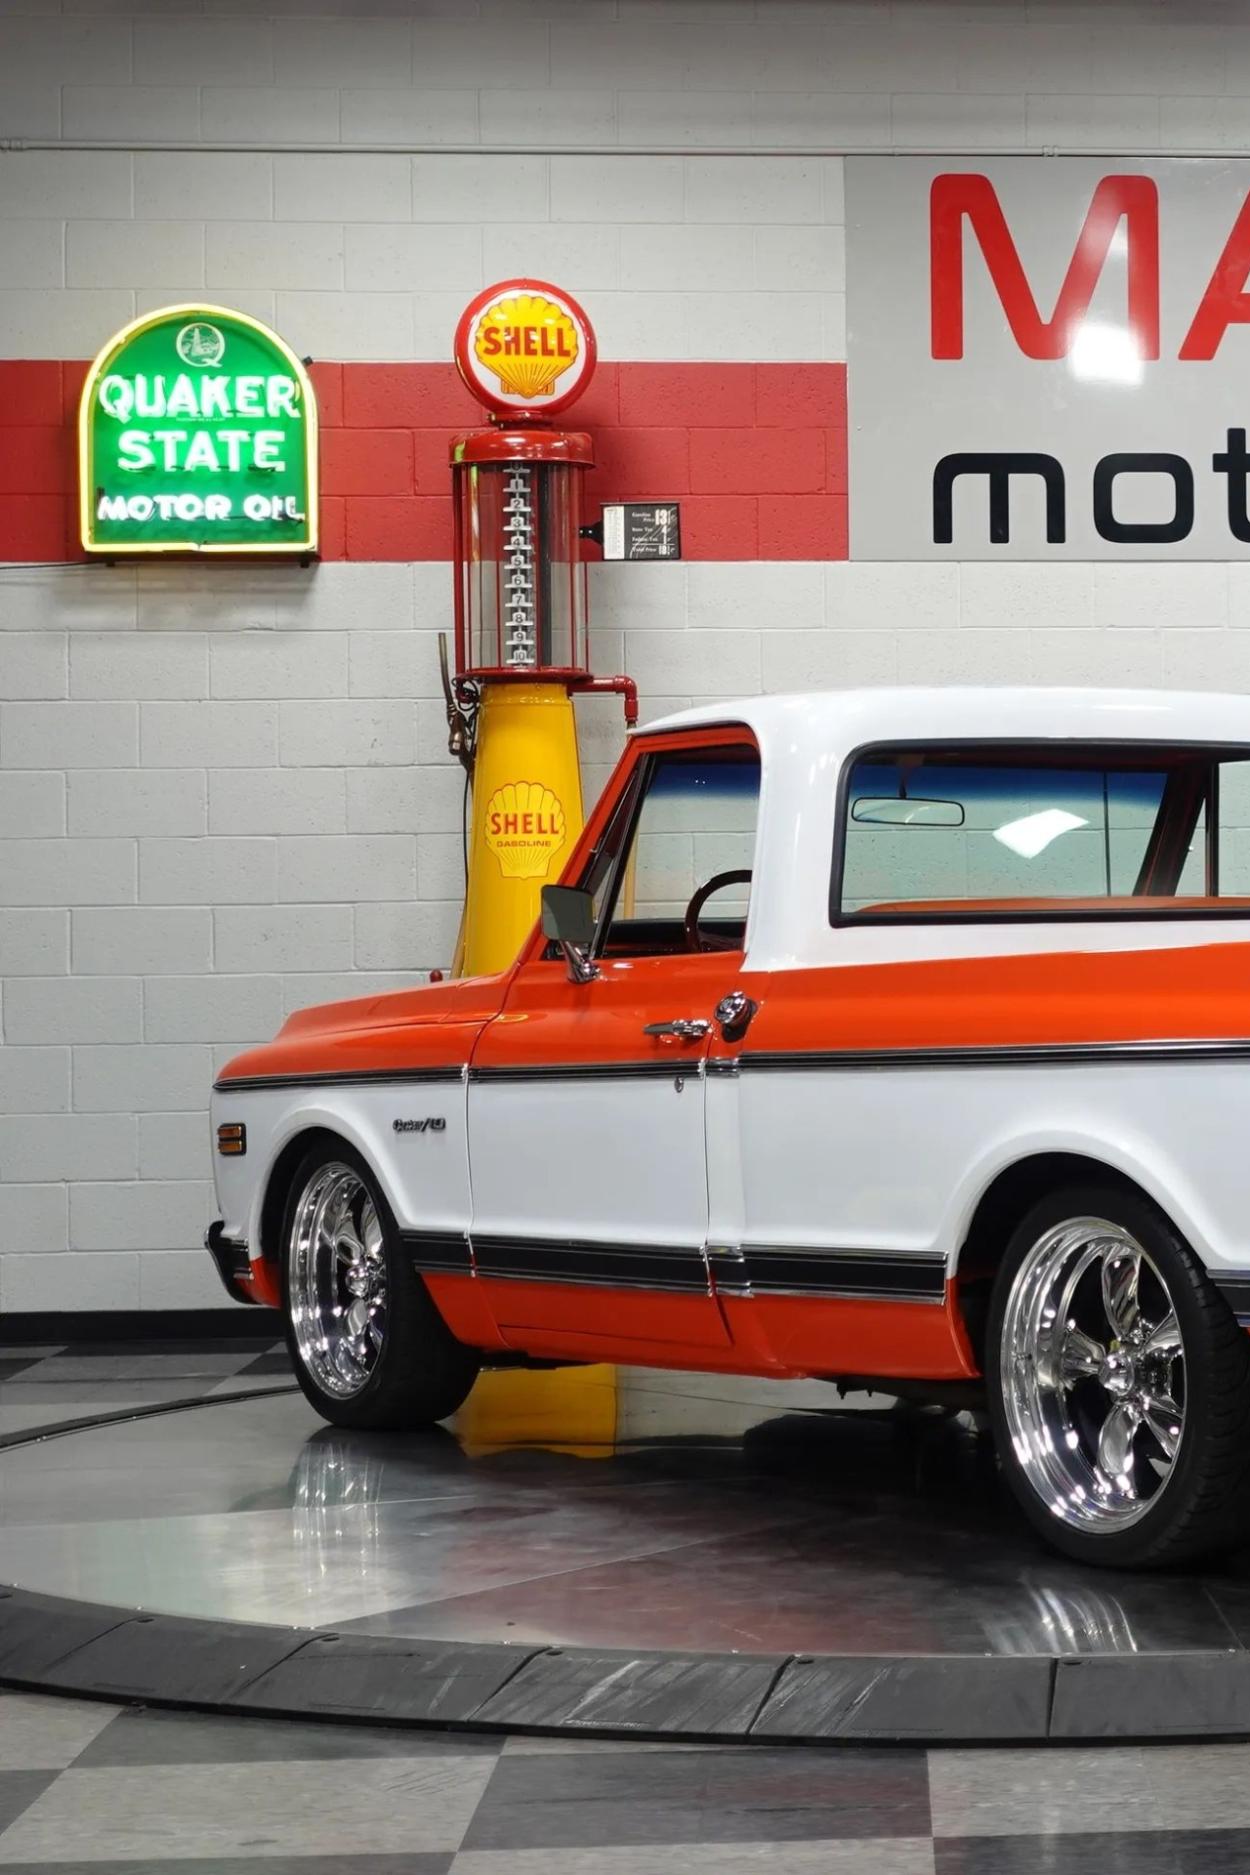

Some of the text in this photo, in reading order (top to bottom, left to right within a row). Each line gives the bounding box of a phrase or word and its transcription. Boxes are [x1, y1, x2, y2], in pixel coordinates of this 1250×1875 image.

[483, 326, 571, 358] SHELL
[98, 373, 301, 424] QUAKER
[118, 429, 286, 473] STATE
[98, 493, 305, 521] MOTOR OIL
[491, 812, 559, 835] SHELL
[496, 840, 551, 848] GASOLINE
